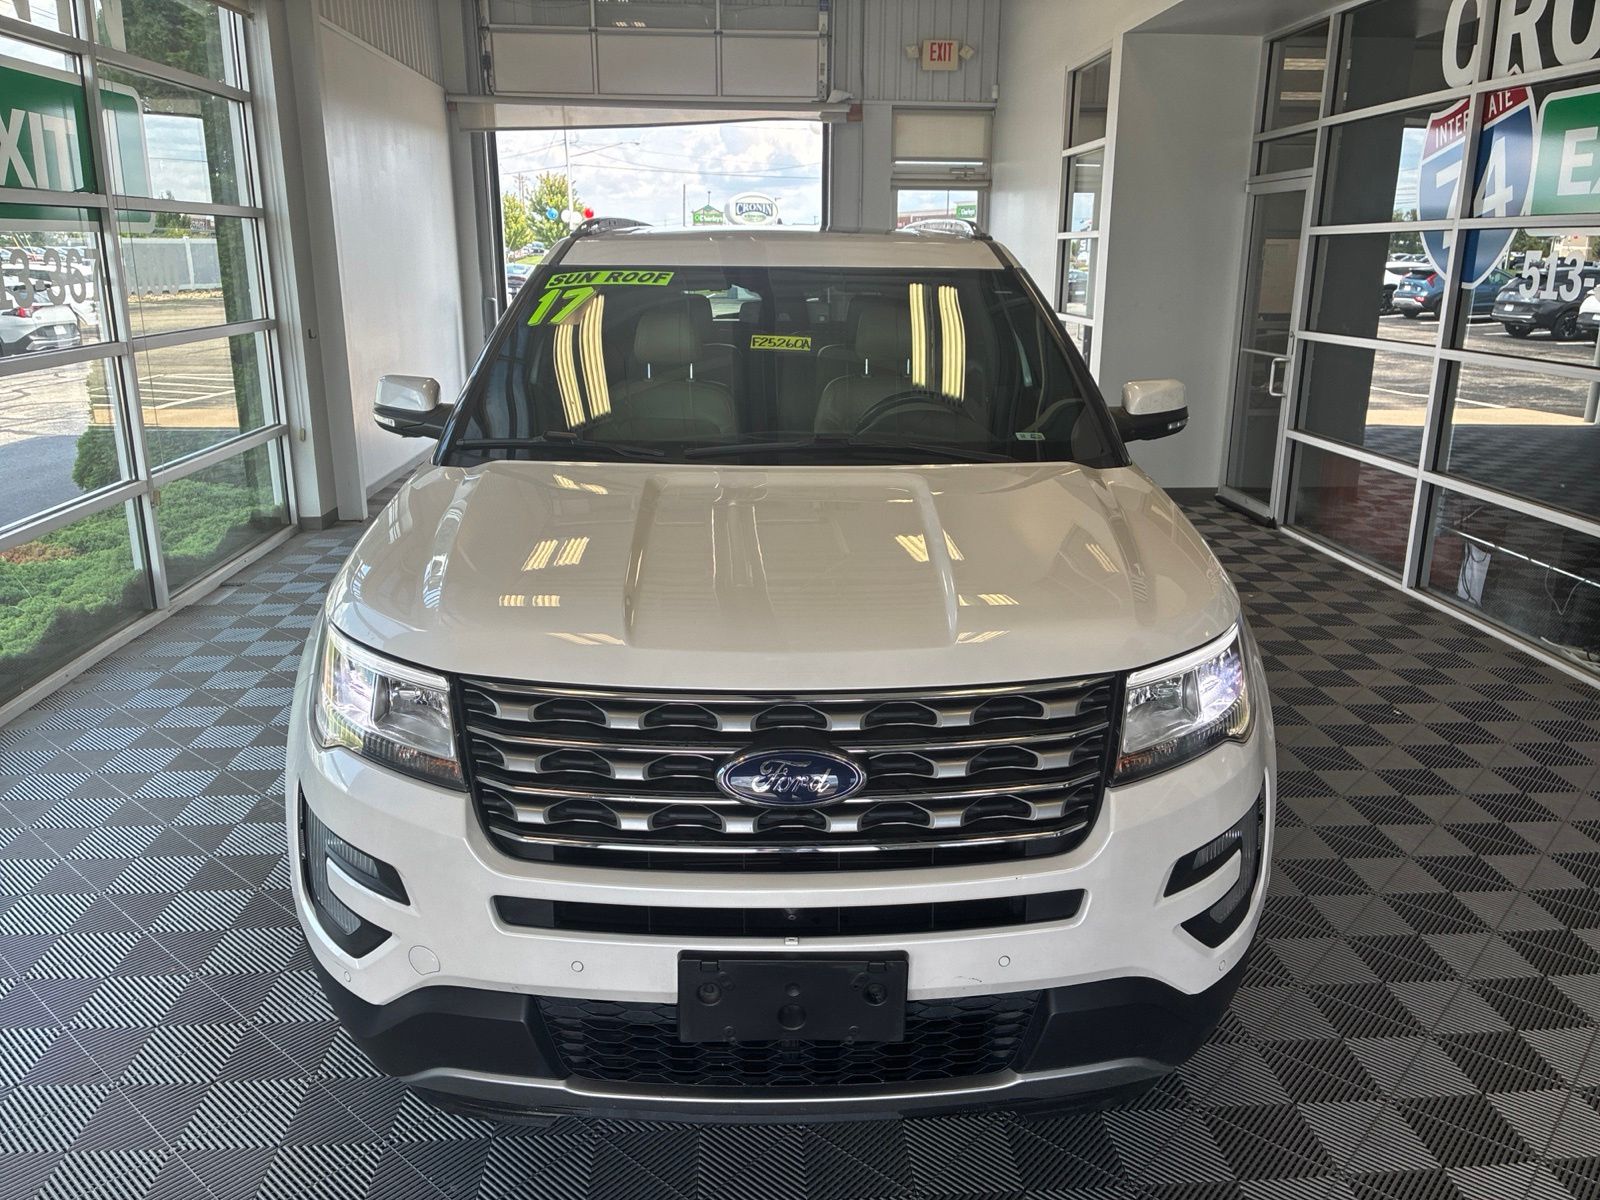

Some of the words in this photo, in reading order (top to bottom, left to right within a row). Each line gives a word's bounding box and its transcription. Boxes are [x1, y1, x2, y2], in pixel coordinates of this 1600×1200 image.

[930, 42, 953, 62] EXIT
[1436, 91, 1513, 149] INTERATE
[1557, 126, 1600, 196] E
[736, 203, 772, 216] CRONIN
[1436, 136, 1514, 249] 74
[548, 272, 600, 286] SUN
[604, 271, 669, 284] ROOF
[527, 286, 597, 326] 17
[751, 759, 832, 793] Ford
